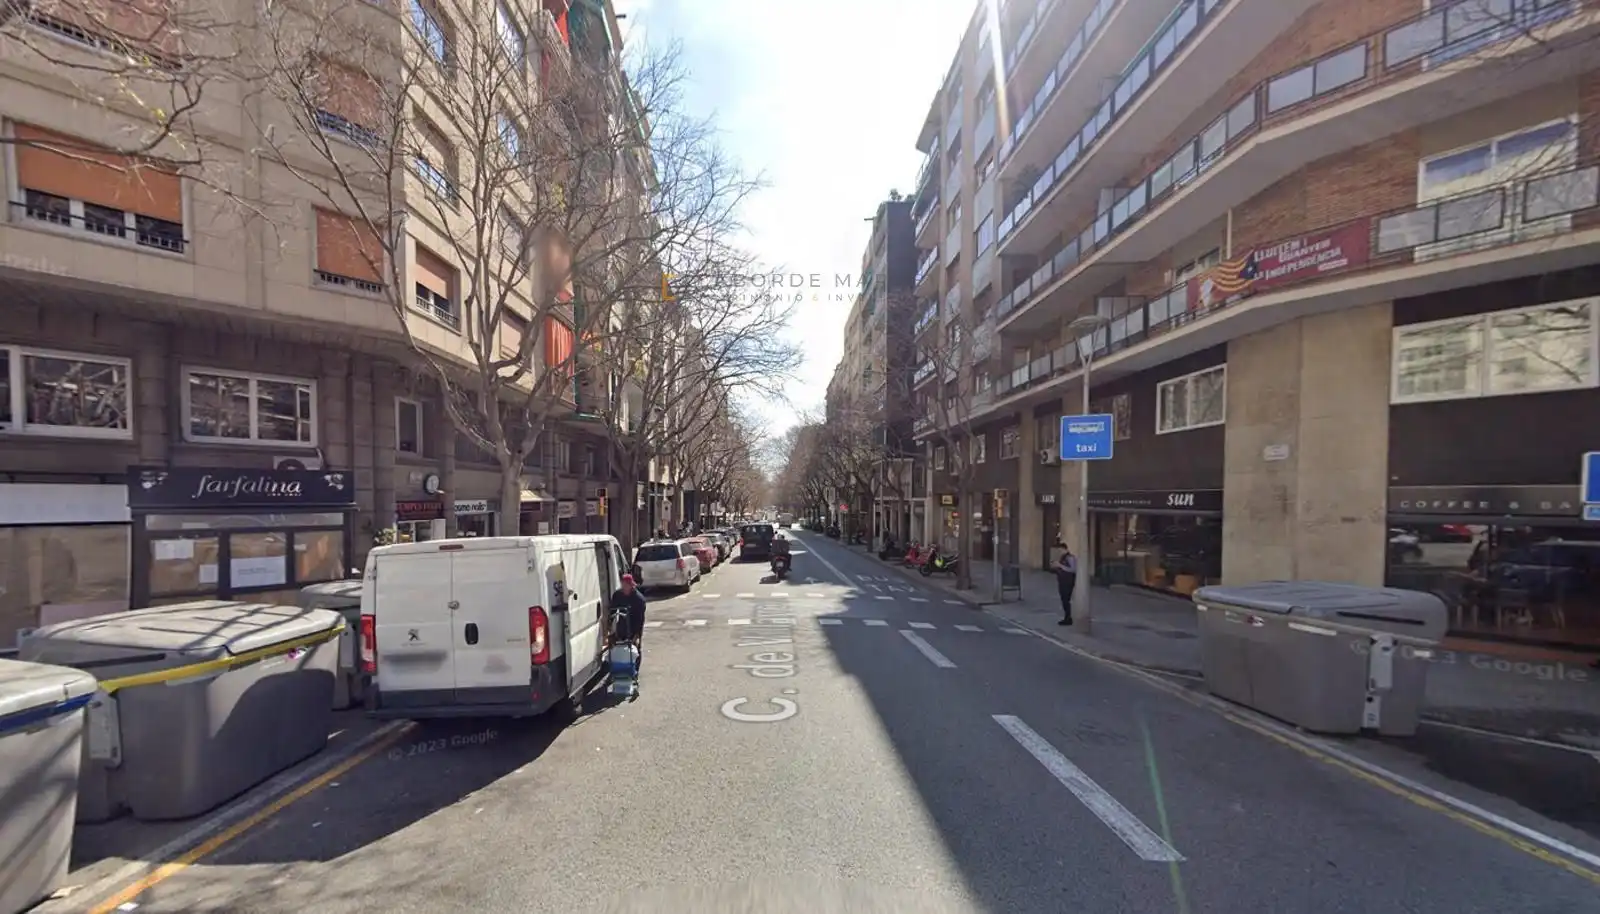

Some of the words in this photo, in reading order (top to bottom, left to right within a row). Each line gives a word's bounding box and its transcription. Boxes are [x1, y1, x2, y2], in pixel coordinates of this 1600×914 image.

[1076, 443, 1097, 453] taxi
[192, 475, 302, 498] farfalina
[1167, 493, 1195, 507] sun
[1400, 500, 1490, 509] COFFEE
[1540, 501, 1572, 510] BA
